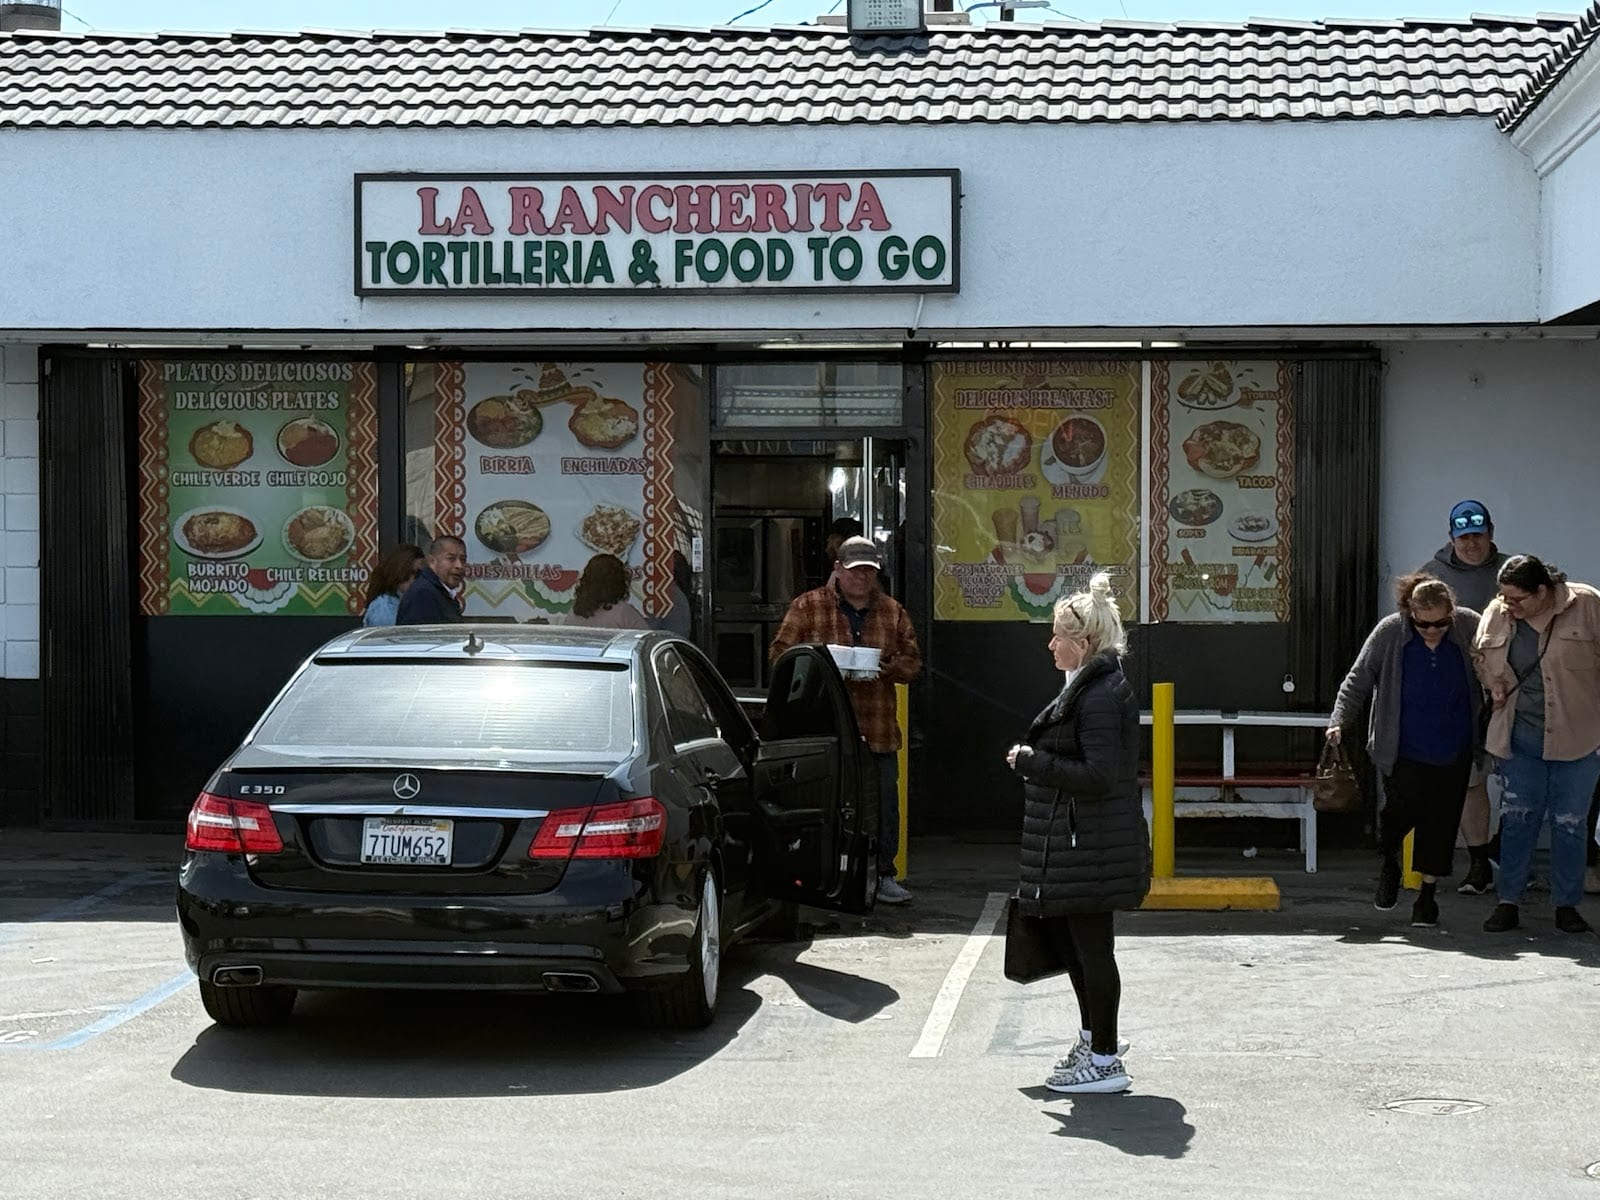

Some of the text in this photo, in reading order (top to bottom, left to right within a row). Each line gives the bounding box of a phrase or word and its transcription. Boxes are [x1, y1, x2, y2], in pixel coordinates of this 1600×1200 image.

[417, 182, 892, 236] LA RANCHERITA
[365, 235, 946, 285] TORTILLERIA & FOOD TO GO
[164, 363, 354, 382] PLATOS DELICIOSOS
[175, 391, 339, 410] DELICIOUS PLATES
[955, 389, 1114, 408] DELICIOUS BREAKFAST
[481, 457, 535, 474] BIRRIA
[561, 457, 649, 475] ENCHILADAS
[172, 471, 260, 486] CHILE VERDE
[267, 471, 347, 486] CHILE ROJO
[1237, 476, 1276, 488] TACOS
[1052, 484, 1109, 498] MENUDO
[187, 563, 249, 578] BURRITO
[267, 567, 369, 582] CHILE RELLENO
[464, 564, 562, 580] QUESADILLAS
[189, 578, 249, 593] MOJADO
[240, 785, 286, 795] E 350
[369, 834, 445, 857] 7TUM652
